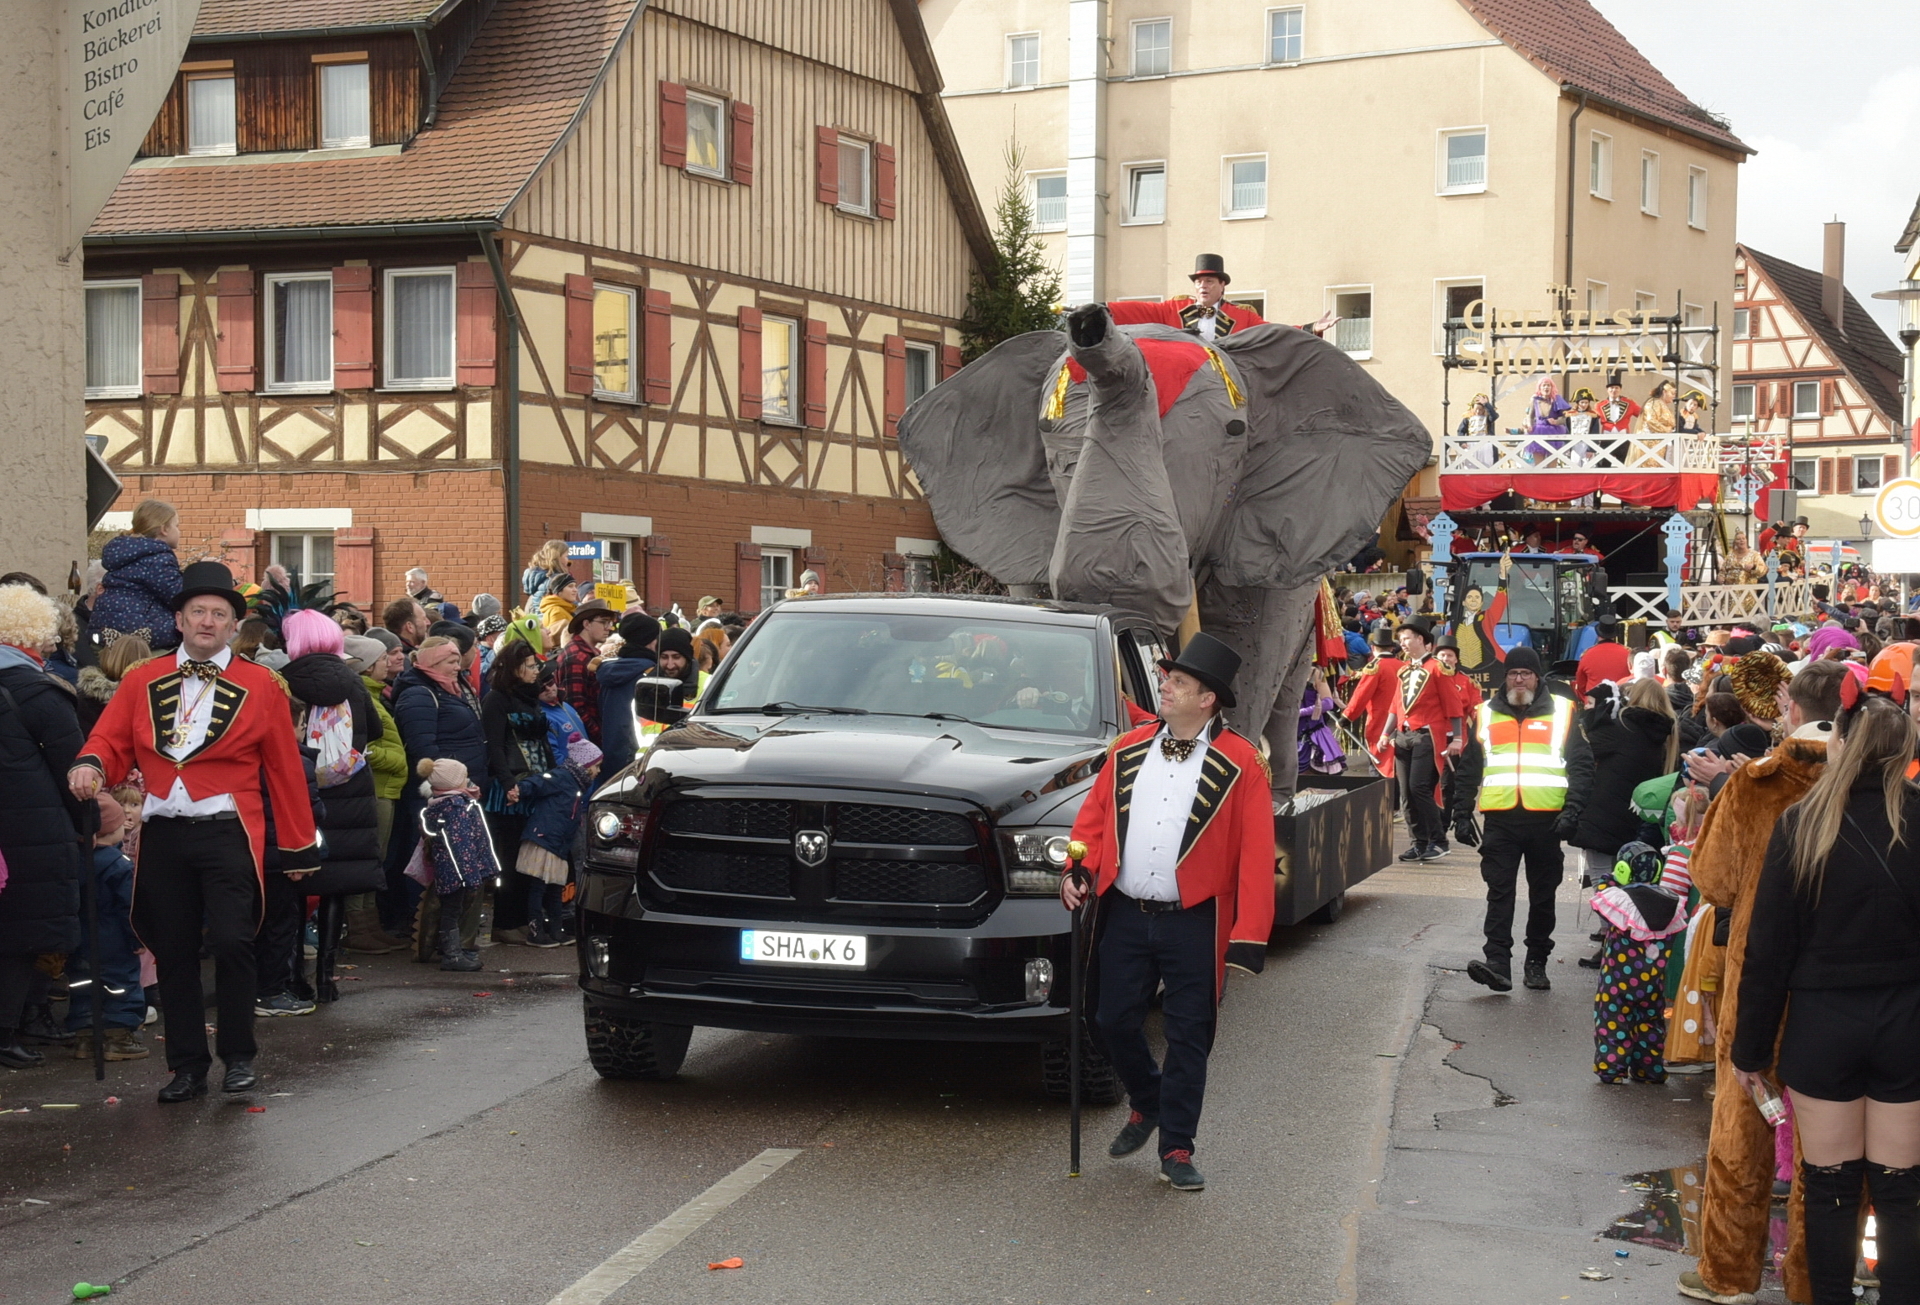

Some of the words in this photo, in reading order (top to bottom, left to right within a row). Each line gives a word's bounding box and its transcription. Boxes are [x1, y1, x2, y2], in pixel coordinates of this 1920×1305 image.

[82, 0, 157, 34] Kondit
[83, 11, 162, 63] Bäckerei
[84, 58, 138, 92] Bistro
[83, 88, 125, 121] Café
[84, 127, 111, 151] Eis
[1546, 282, 1578, 300] THE
[1463, 299, 1659, 336] GREATEST
[1457, 336, 1666, 377] SHOWMAN
[1889, 495, 1920, 520] 30
[762, 935, 806, 959] SHA
[822, 938, 837, 961] K
[843, 939, 856, 961] 6
